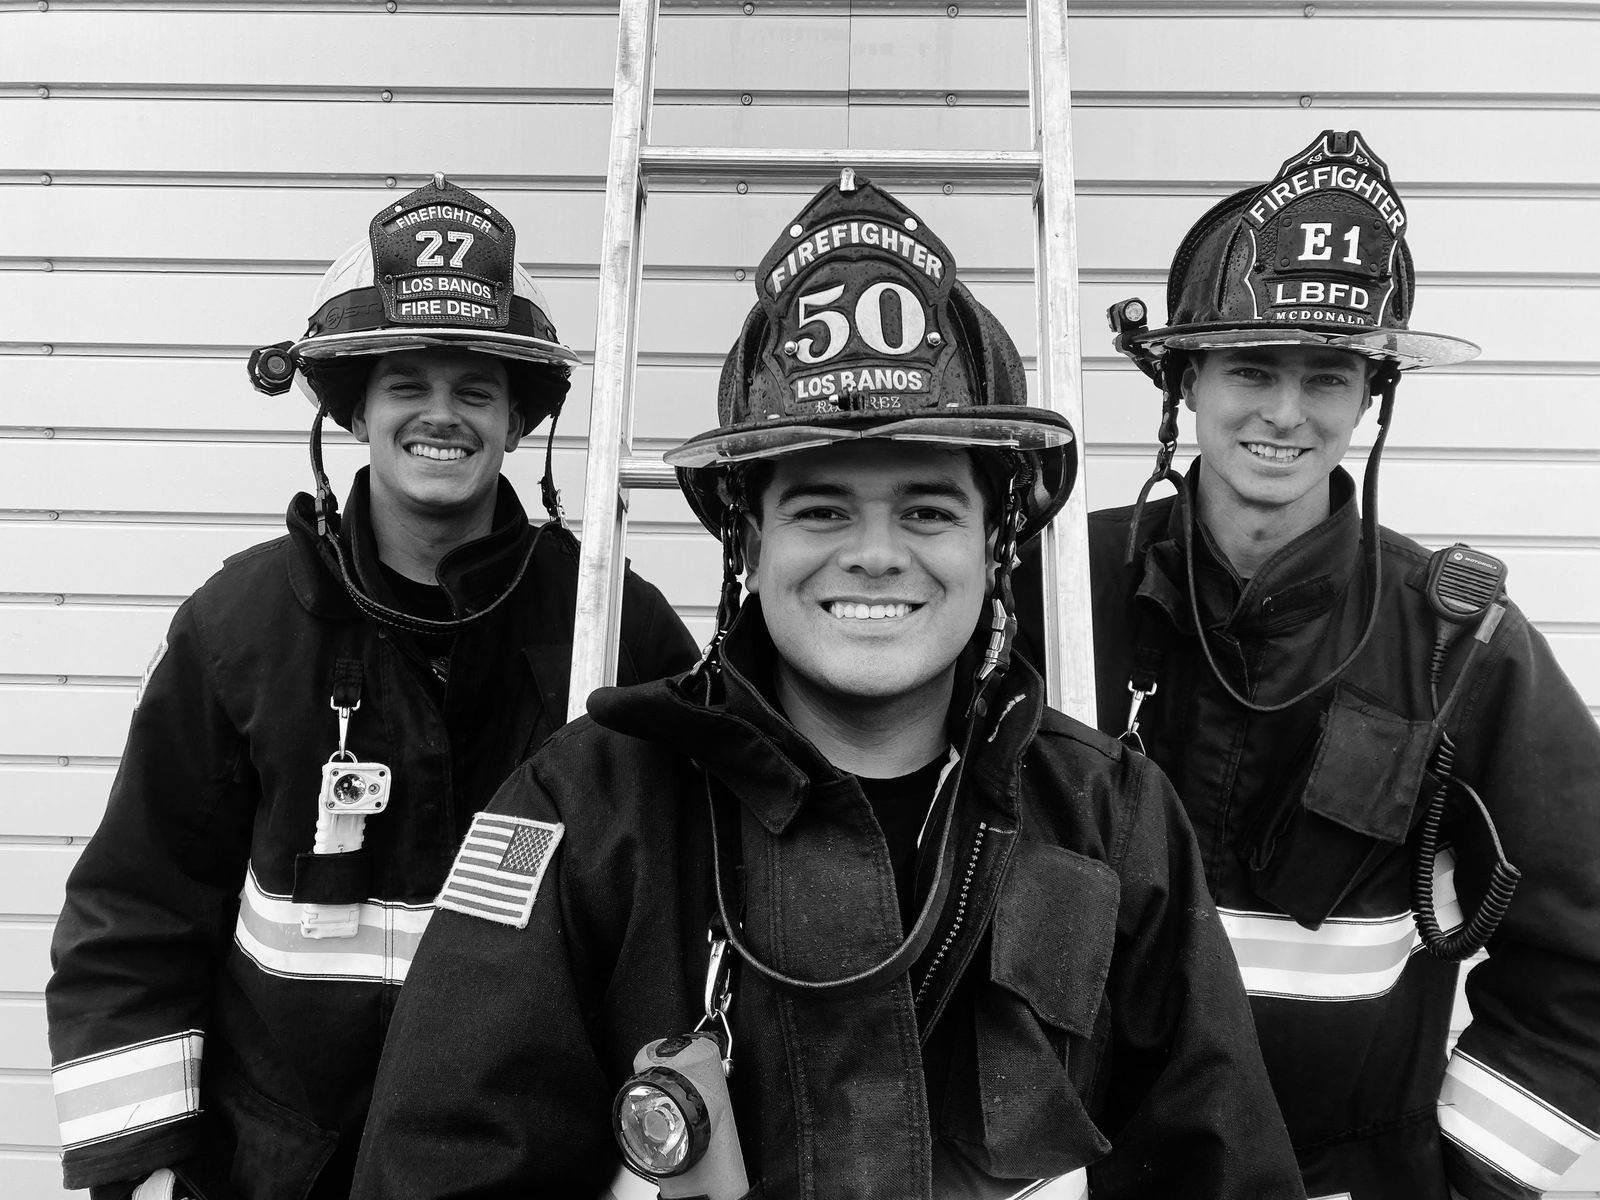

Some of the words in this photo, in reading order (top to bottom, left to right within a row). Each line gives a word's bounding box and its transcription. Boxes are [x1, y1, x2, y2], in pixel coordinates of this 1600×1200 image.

[1250, 166, 1405, 233] FIREFIGHTER
[396, 205, 492, 233] FIREFIGHTER
[415, 230, 474, 268] 27
[771, 222, 943, 294] FIREFIGHTER
[402, 277, 434, 294] LOS
[438, 277, 491, 299] BANOS
[1276, 282, 1369, 310] LBFD
[401, 300, 441, 316] FIRE
[447, 301, 495, 320] DEPT.
[797, 282, 926, 364] 50
[1276, 311, 1365, 325] MCDONALD
[797, 374, 836, 399] LOS
[840, 369, 923, 392] BANOS
